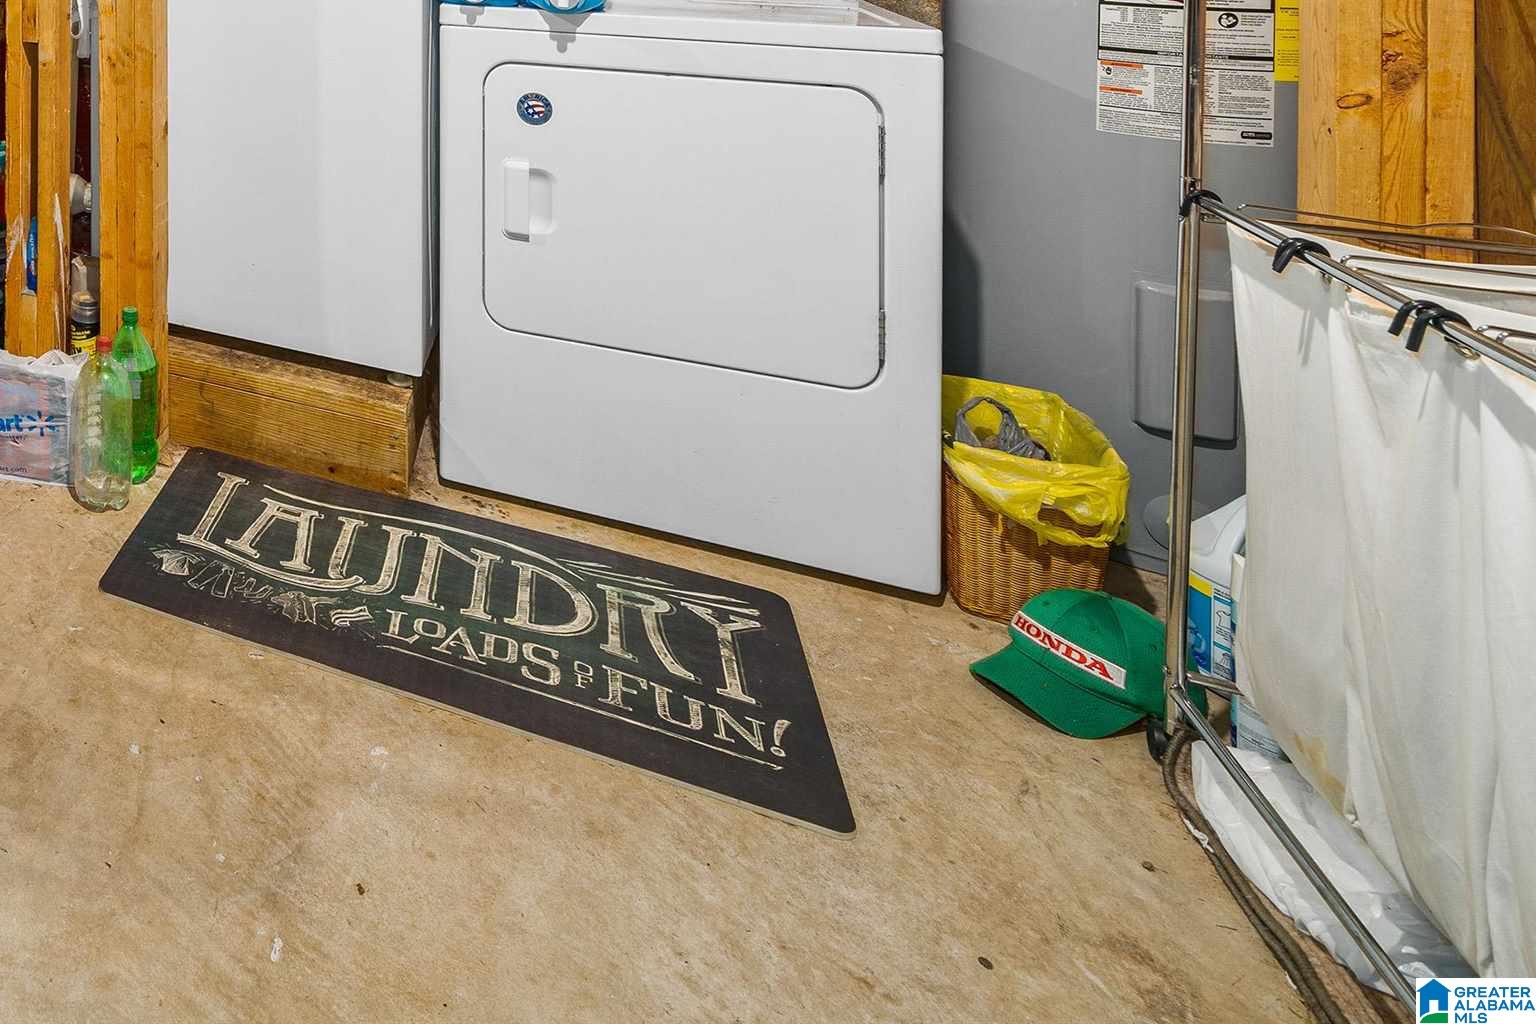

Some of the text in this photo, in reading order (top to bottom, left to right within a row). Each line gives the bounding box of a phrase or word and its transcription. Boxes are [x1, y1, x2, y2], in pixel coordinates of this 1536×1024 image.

[177, 471, 764, 706] LAUNDRY
[1014, 615, 1114, 681] HONDA
[381, 608, 792, 758] LOADS OF FUN!
